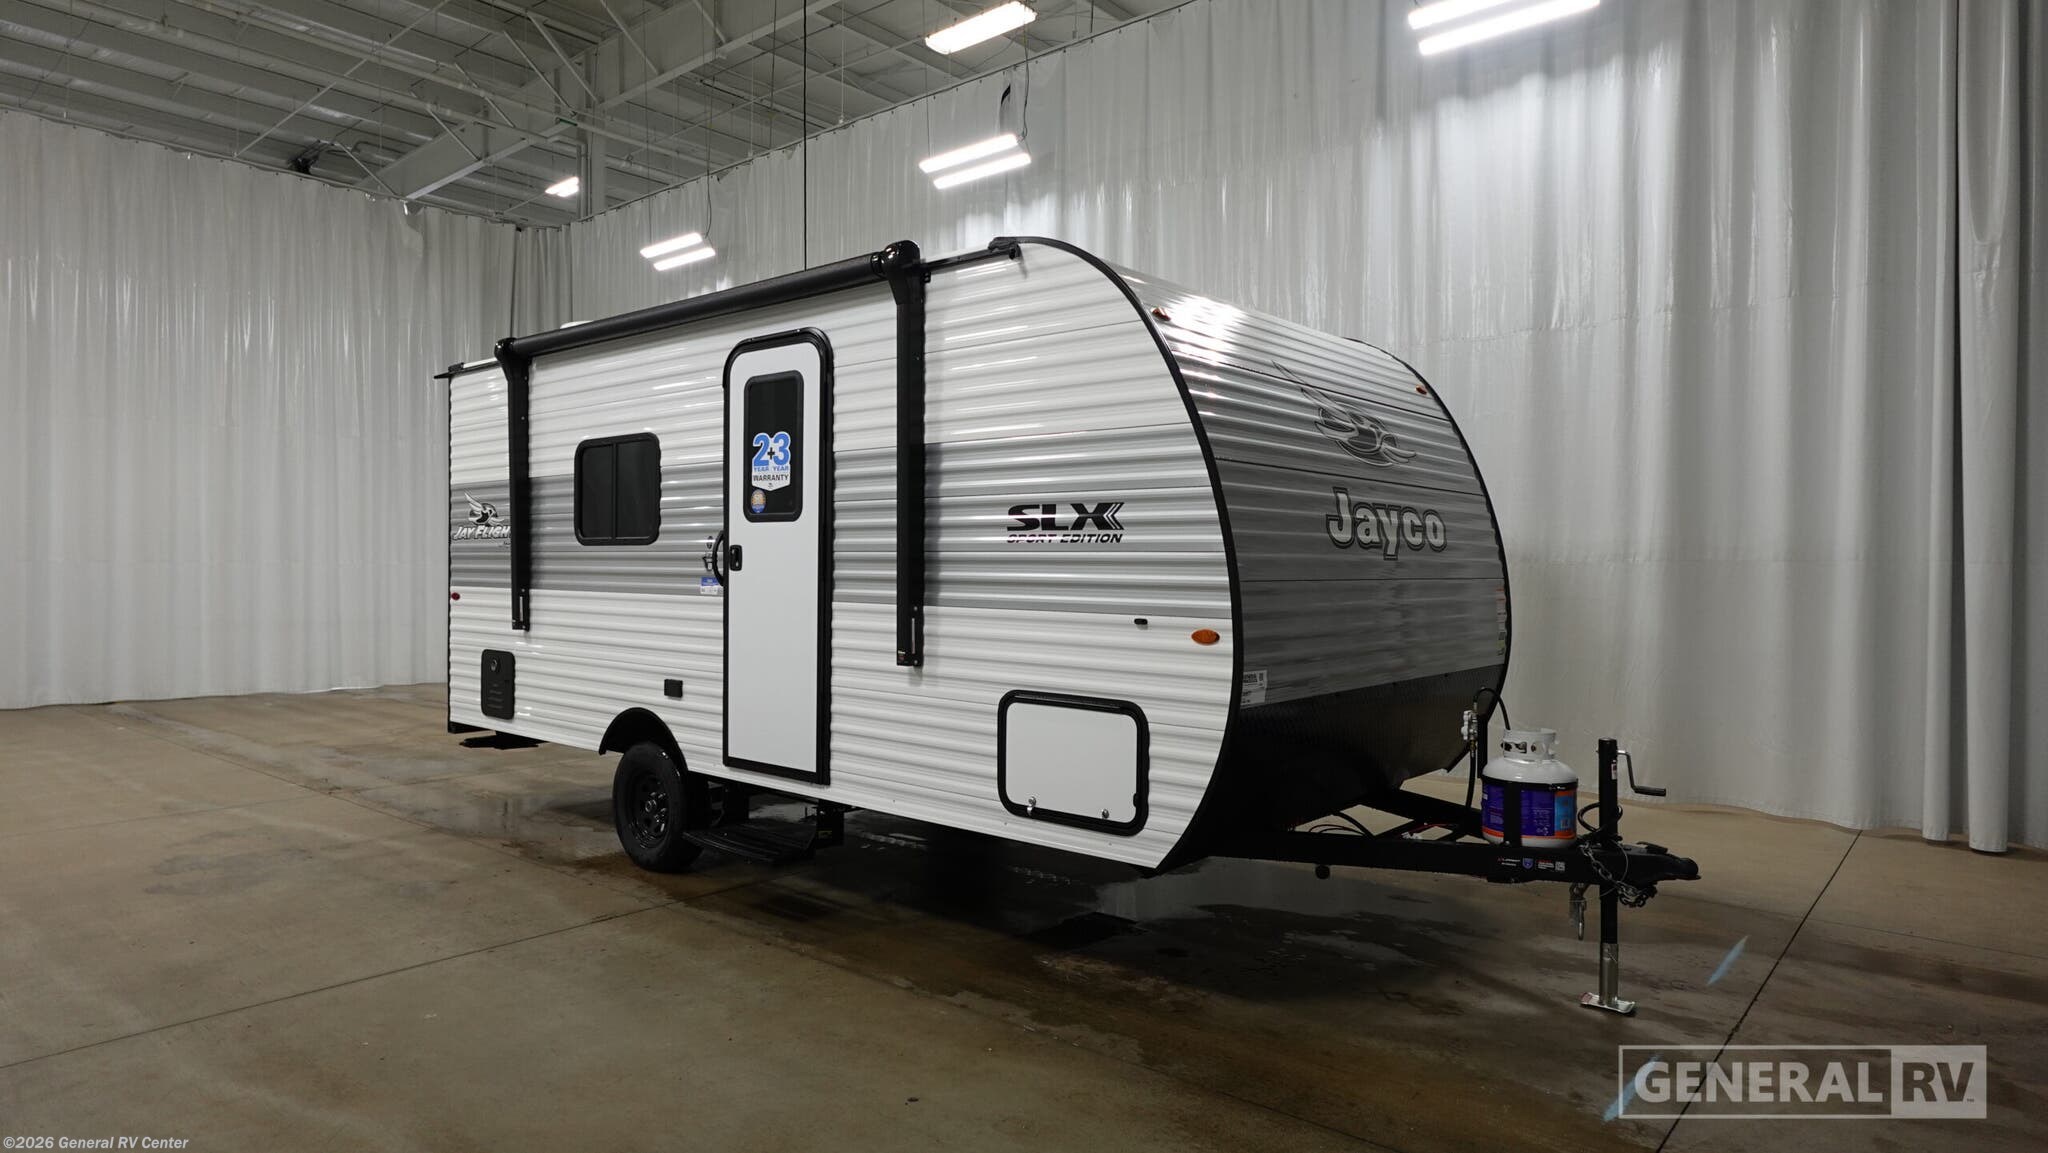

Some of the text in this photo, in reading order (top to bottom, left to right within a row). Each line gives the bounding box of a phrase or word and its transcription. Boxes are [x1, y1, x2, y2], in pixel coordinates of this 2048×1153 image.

[1007, 502, 1125, 531] SLX
[1326, 487, 1447, 560] Jayco
[453, 525, 511, 540] JAY FLIGH
[1007, 533, 1123, 543] SPORT EDITION
